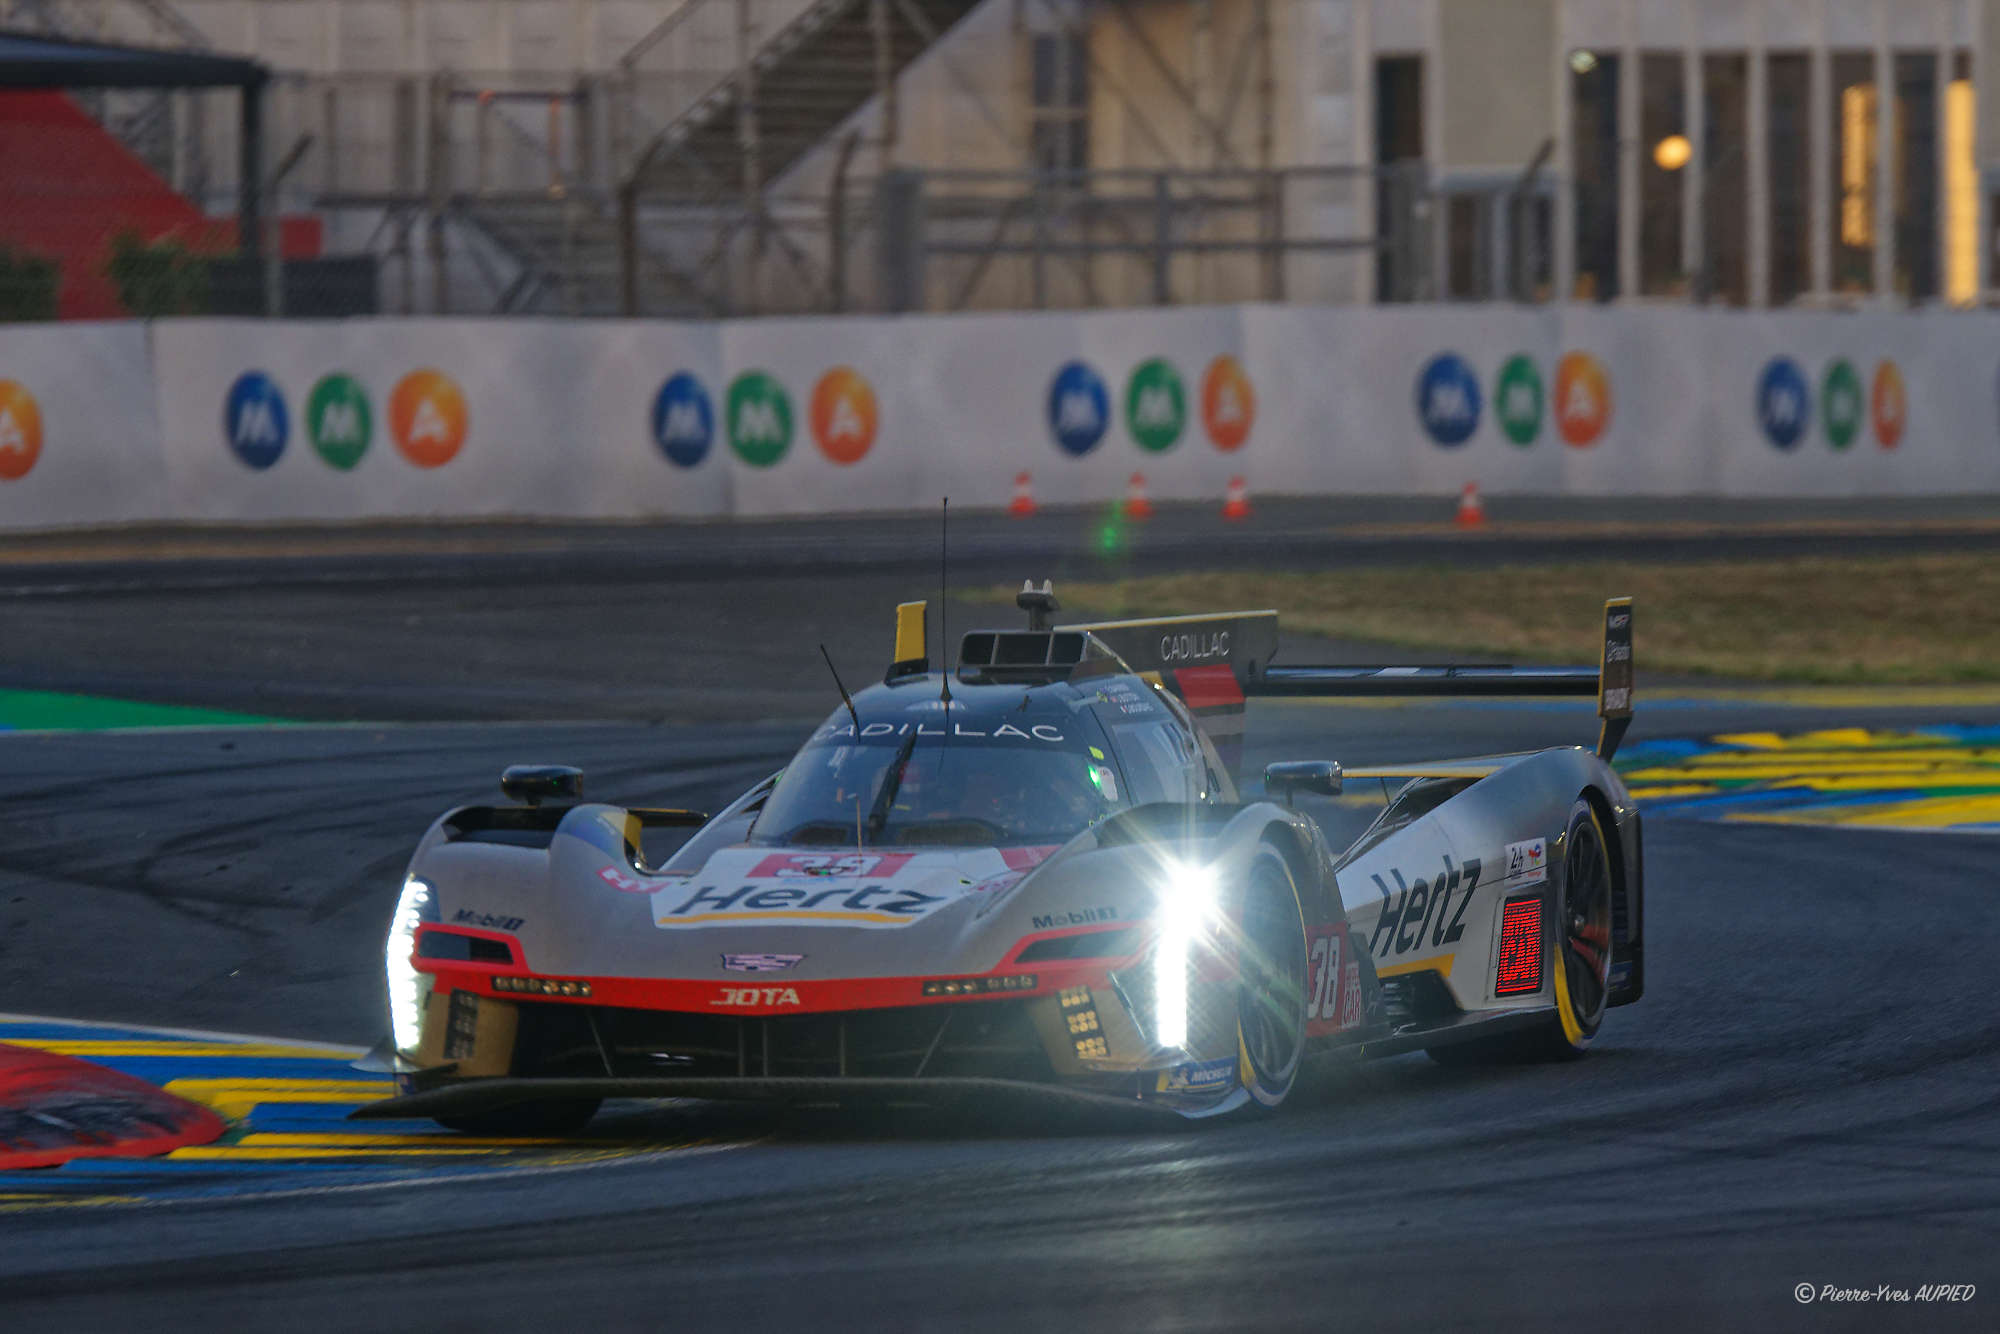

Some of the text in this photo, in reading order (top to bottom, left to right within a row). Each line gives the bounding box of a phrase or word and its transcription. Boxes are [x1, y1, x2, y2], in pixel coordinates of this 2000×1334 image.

[1160, 631, 1230, 661] CADILLAC
[812, 722, 1064, 743] CADILLAC
[669, 885, 948, 915] Hertz
[1369, 854, 1482, 958] Hertz
[1308, 935, 1341, 1020] 38
[709, 988, 801, 1006] JOTA
[1343, 989, 1361, 1026] CAR
